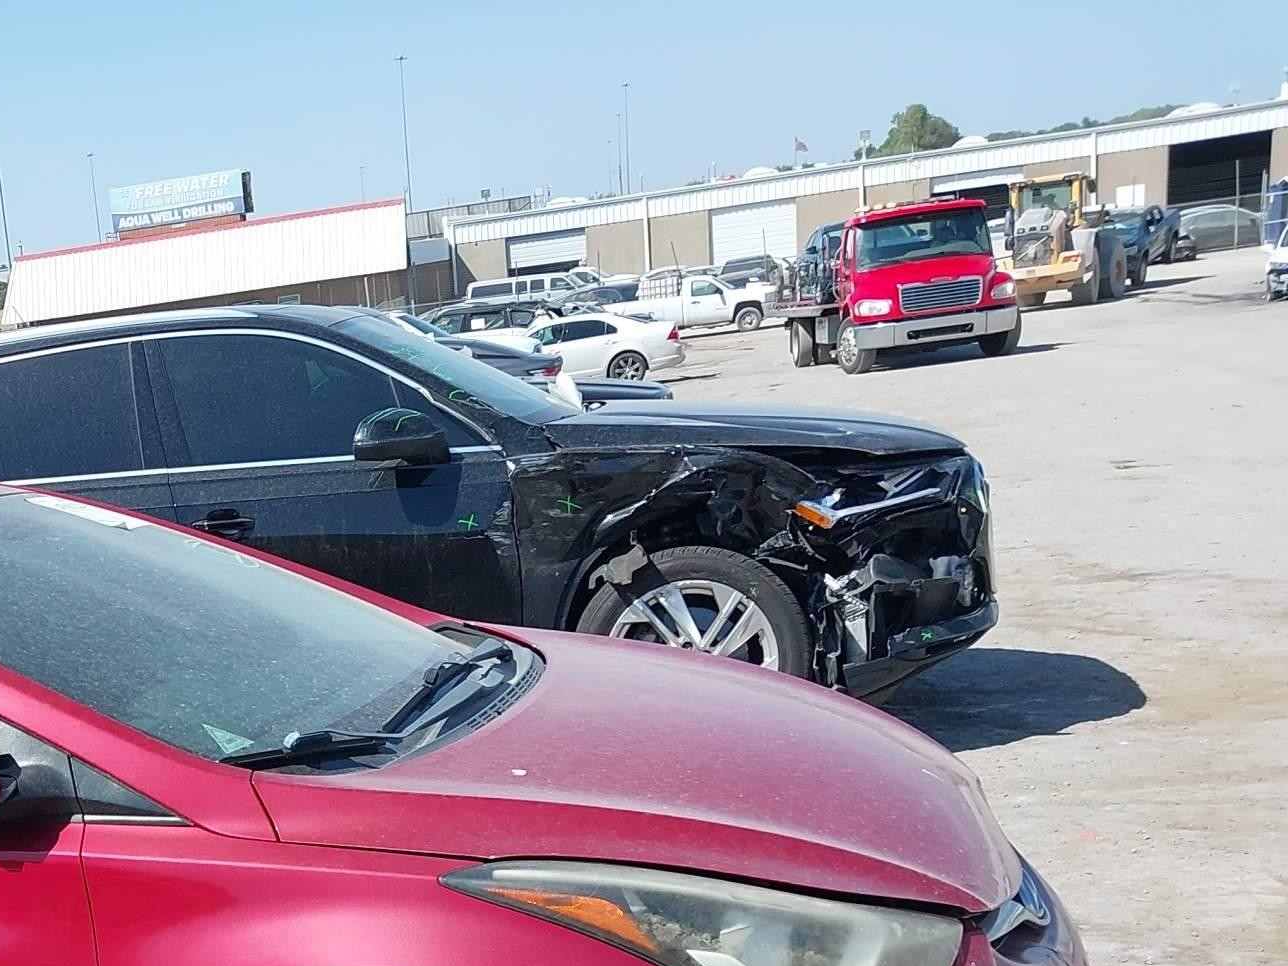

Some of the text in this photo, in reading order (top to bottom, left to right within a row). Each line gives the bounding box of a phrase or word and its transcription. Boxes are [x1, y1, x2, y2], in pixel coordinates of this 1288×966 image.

[135, 182, 171, 198] FREE
[175, 174, 229, 191] WATER
[119, 202, 234, 229] AQUA WELL DRILLING
